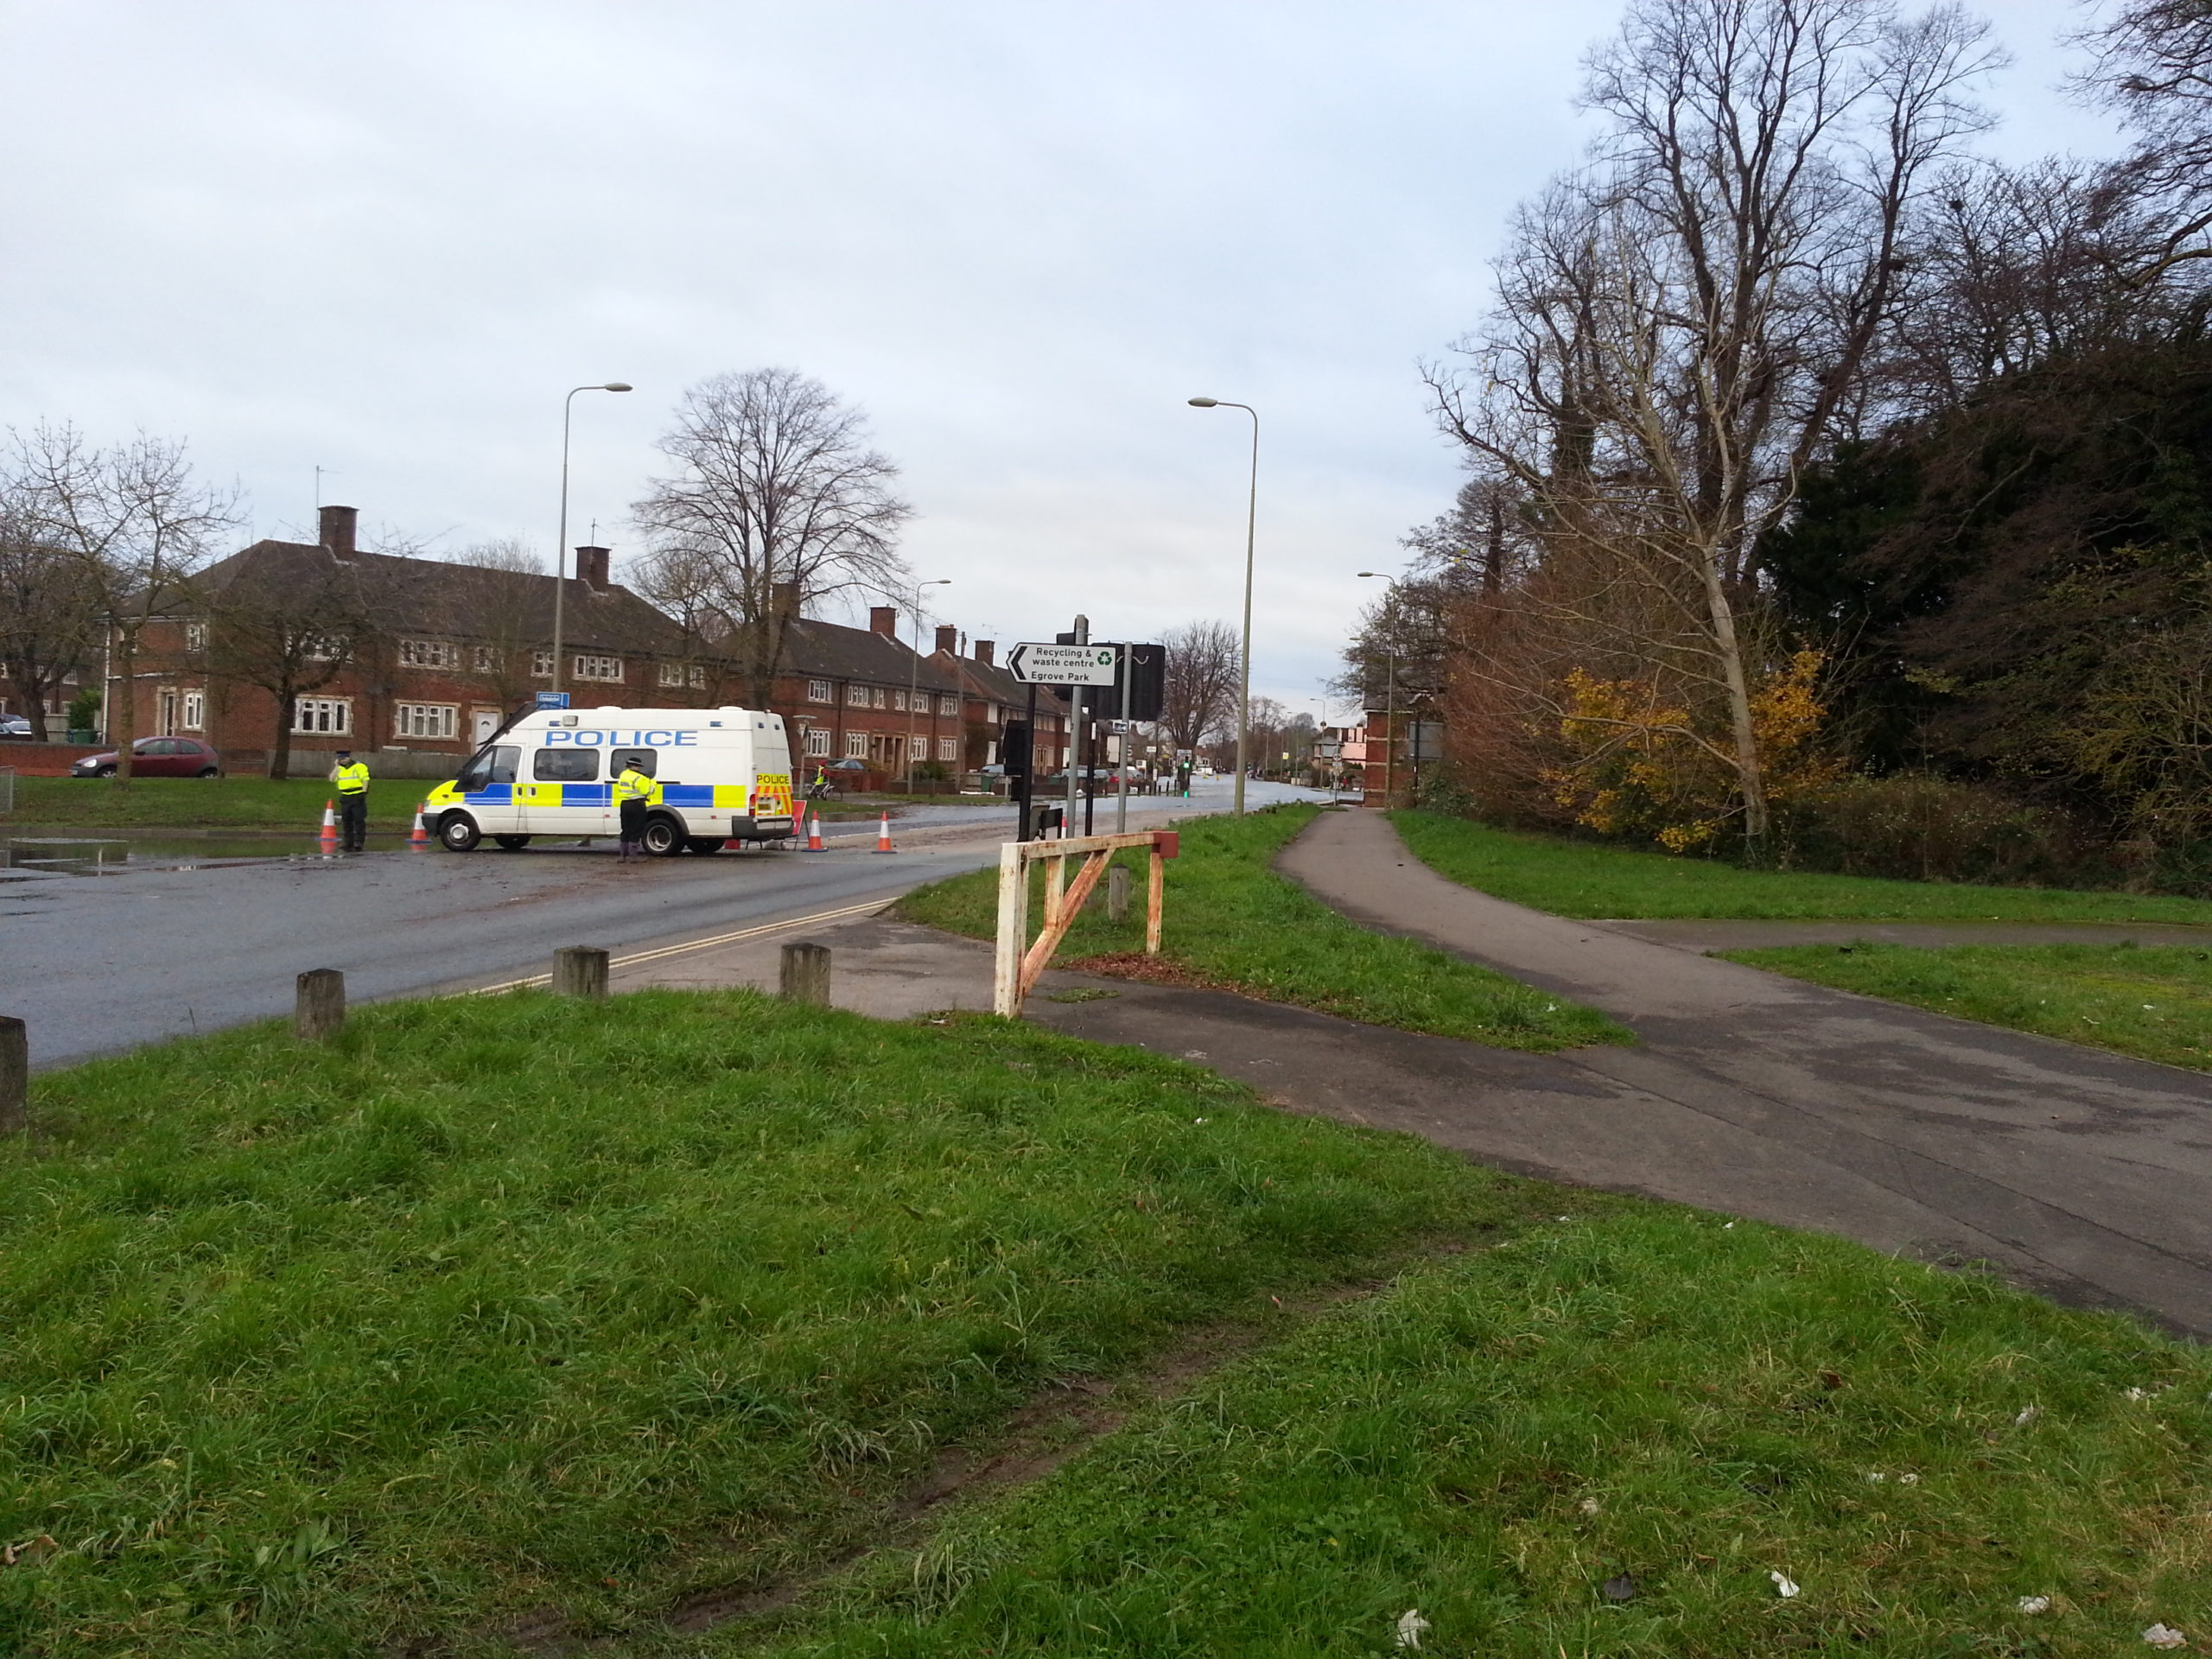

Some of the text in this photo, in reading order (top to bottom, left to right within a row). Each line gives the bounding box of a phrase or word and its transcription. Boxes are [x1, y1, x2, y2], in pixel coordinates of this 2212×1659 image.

[1036, 647, 1092, 658] Recycling &
[1064, 659, 1095, 668] centre
[1031, 671, 1090, 682] Egrove Park
[545, 730, 698, 747] POLICE
[756, 774, 790, 785] POLICE
